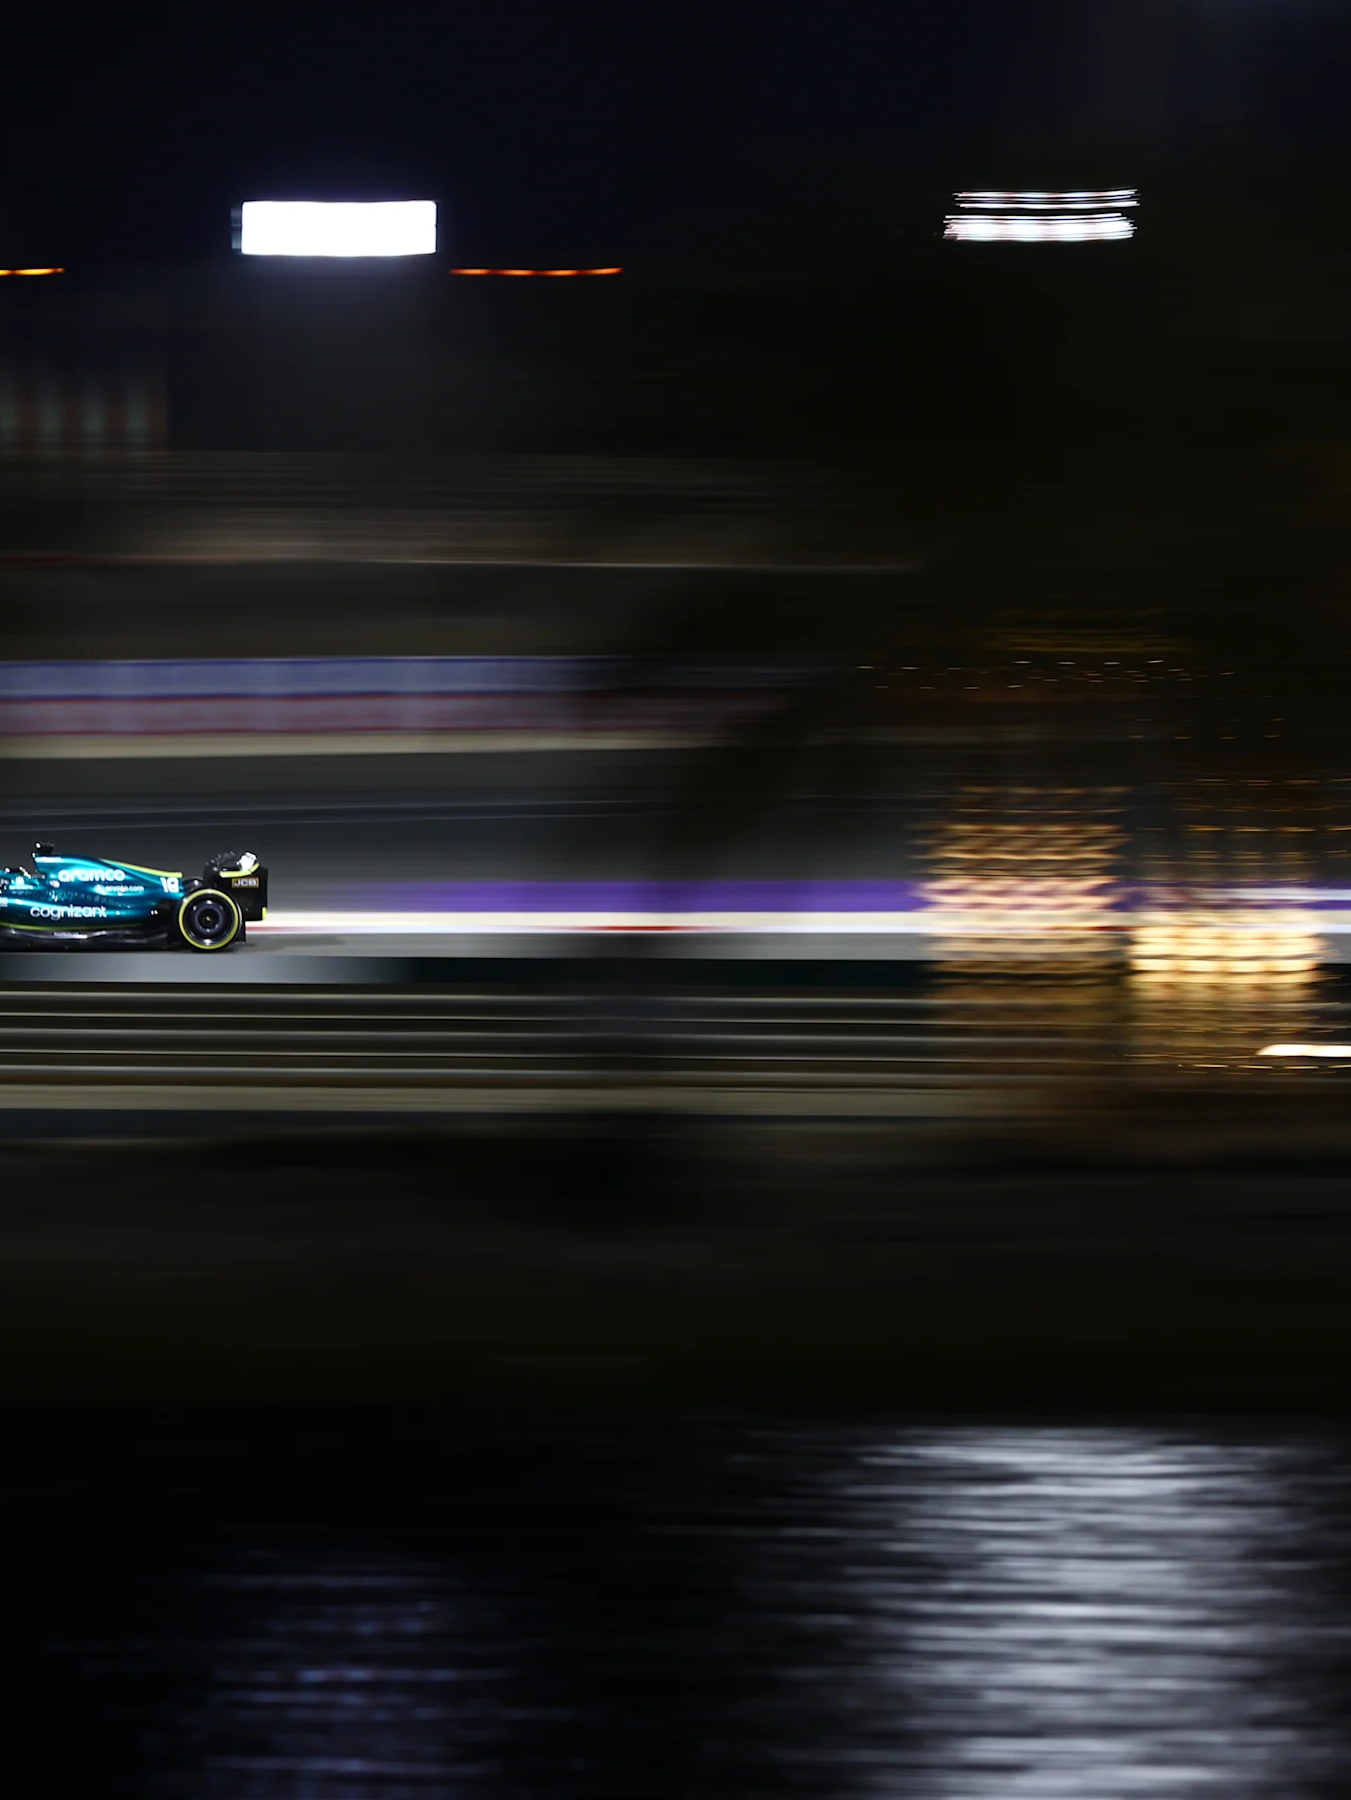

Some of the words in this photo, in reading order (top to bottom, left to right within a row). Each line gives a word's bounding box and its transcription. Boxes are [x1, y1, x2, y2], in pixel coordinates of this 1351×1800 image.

[57, 869, 126, 882] aramco
[105, 885, 145, 893] crypto.com
[160, 877, 179, 893] 18
[234, 878, 257, 887] JCB
[30, 904, 107, 921] cognizant
